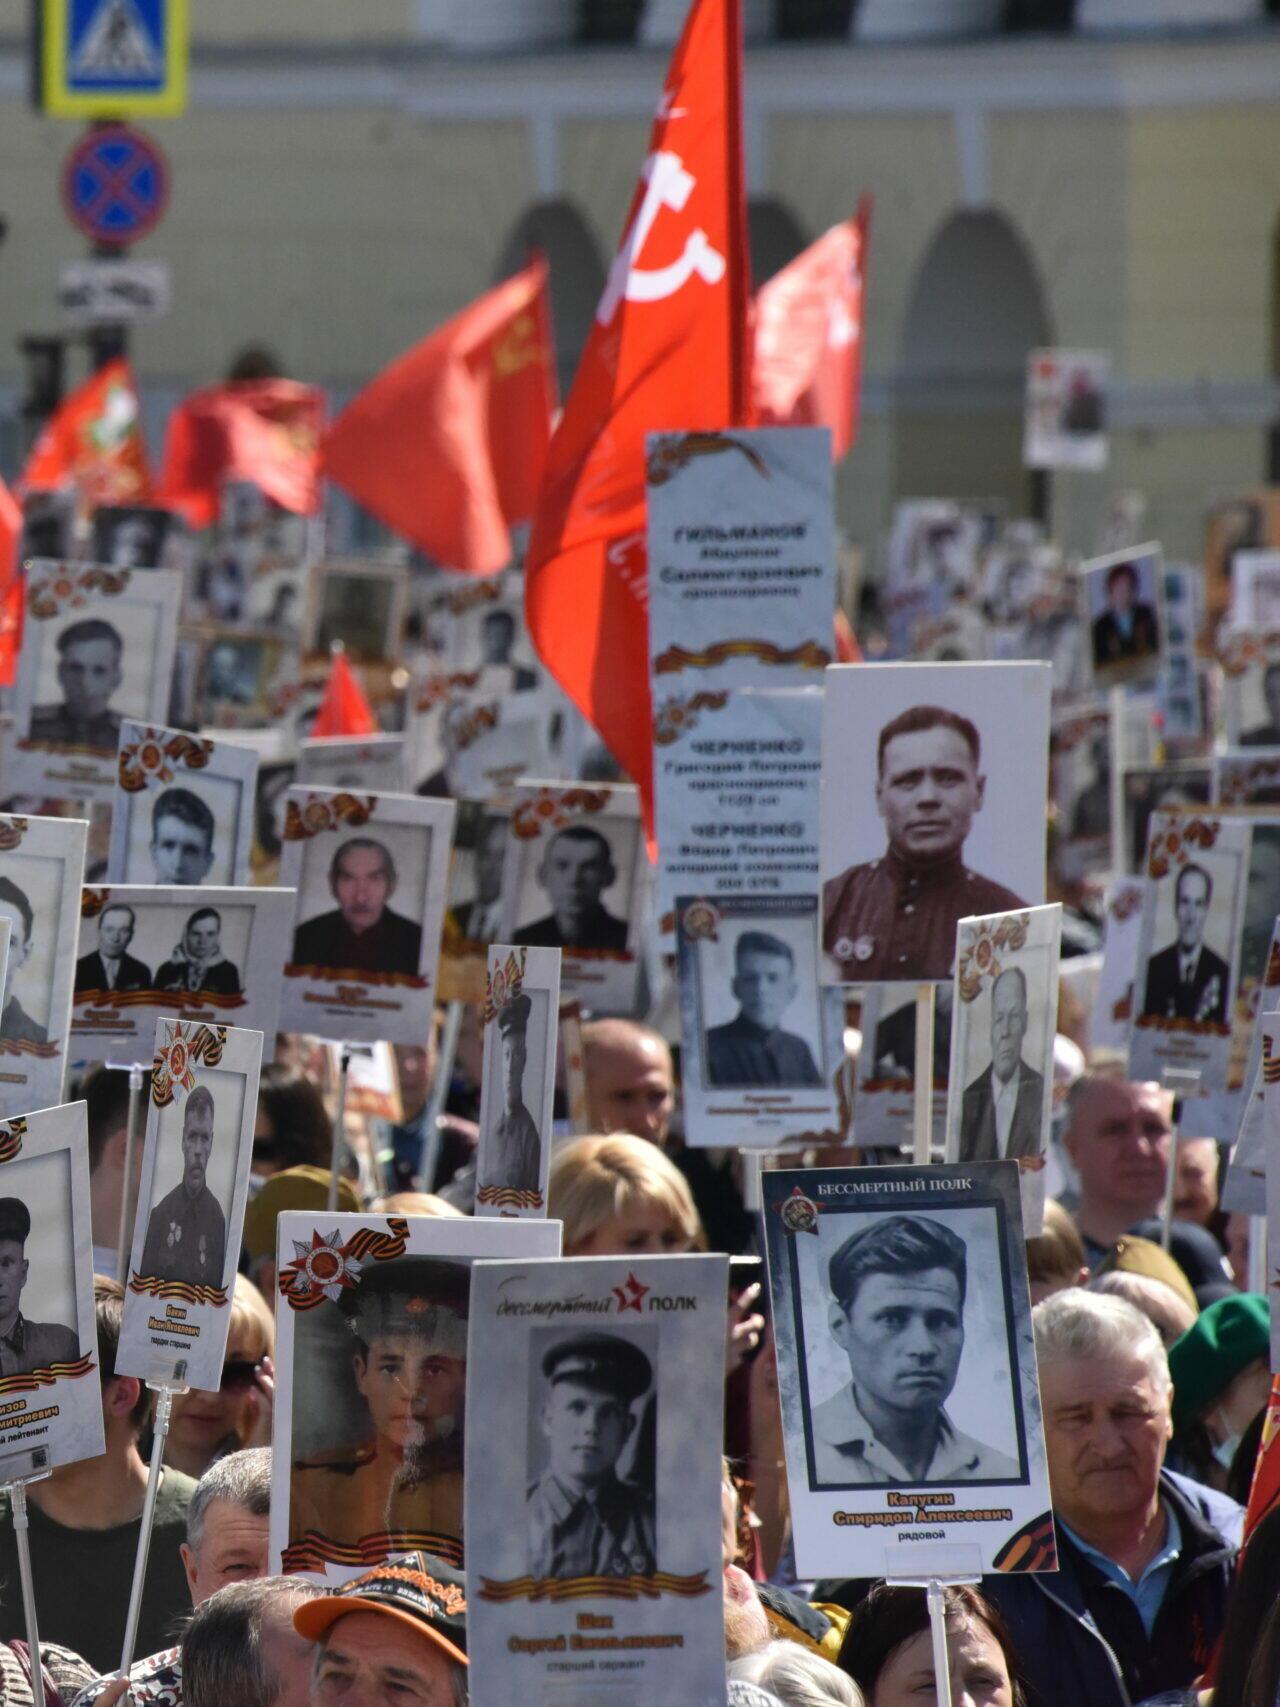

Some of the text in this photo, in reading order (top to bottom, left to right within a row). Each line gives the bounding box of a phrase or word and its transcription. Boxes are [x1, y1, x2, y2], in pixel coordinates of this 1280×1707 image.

[817, 1178, 973, 1195] БЕССМЕРТНЫЙ ПОЛК
[148, 1316, 165, 1331] Иван
[8, 1426, 49, 1443] лейтенант
[887, 1492, 955, 1508] Калугин
[833, 1508, 1013, 1527] Спиридон Алексеевич
[898, 1530, 946, 1542] рядовой
[546, 1659, 646, 1673] старший сержант
